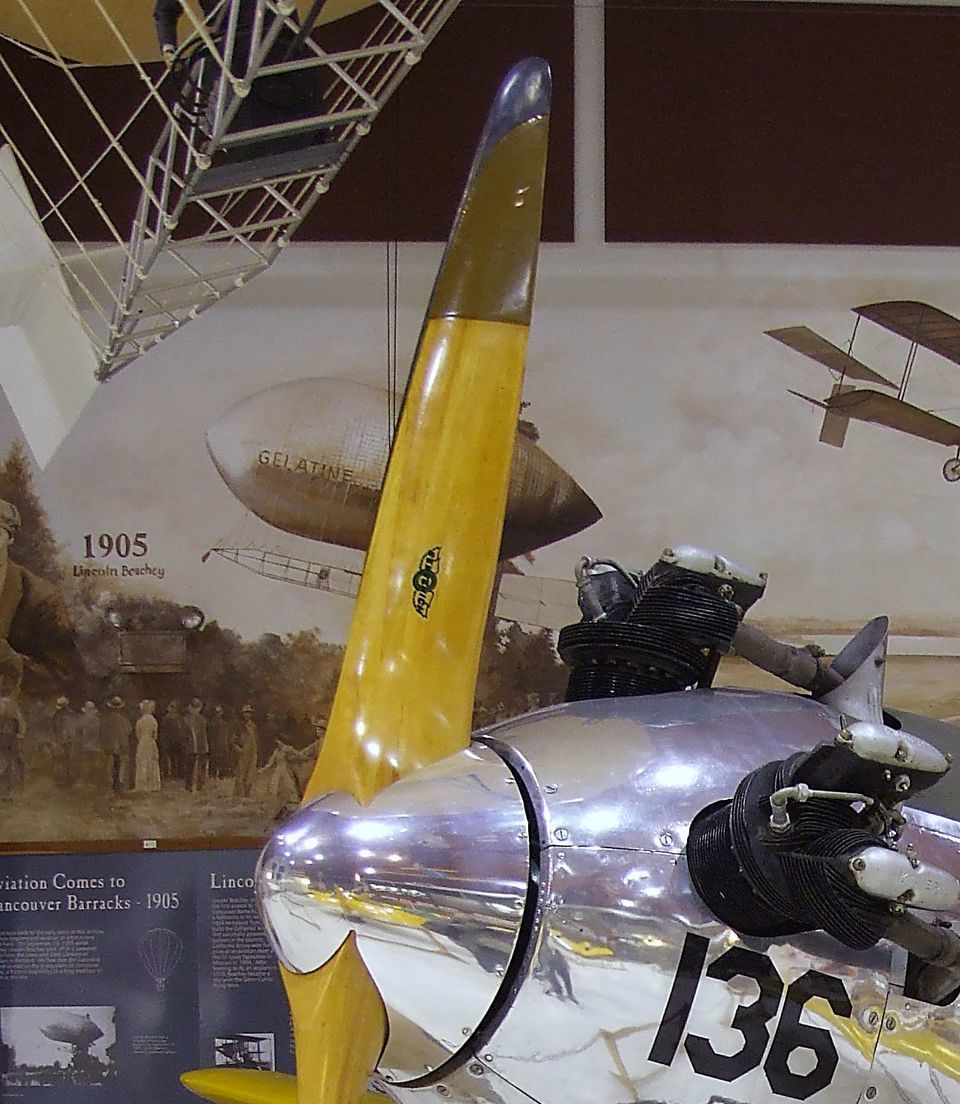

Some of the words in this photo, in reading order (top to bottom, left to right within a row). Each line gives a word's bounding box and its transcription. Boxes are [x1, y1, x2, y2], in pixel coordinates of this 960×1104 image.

[258, 449, 353, 482] GELATINE
[83, 532, 148, 558] 1905
[73, 564, 118, 578] Lincoln
[53, 873, 104, 889] Comes
[110, 877, 126, 888] to
[68, 894, 131, 911] Barracks
[146, 892, 180, 909] 1905
[647, 932, 853, 1101] 136
